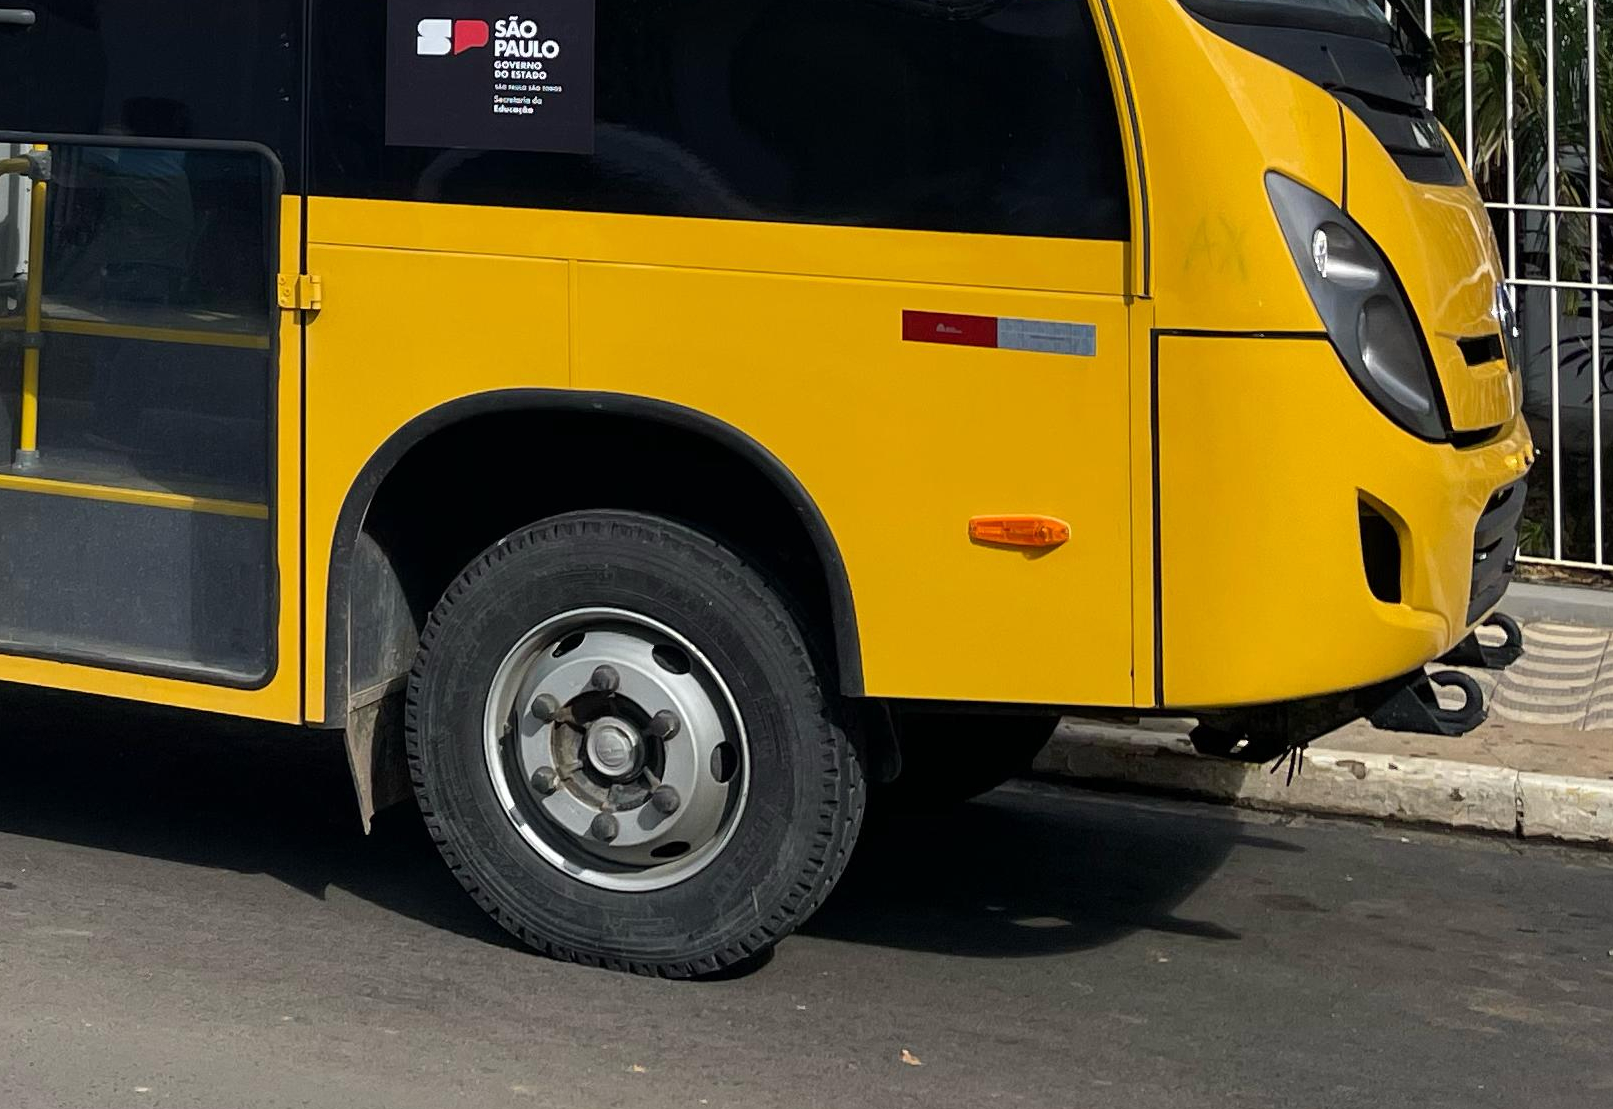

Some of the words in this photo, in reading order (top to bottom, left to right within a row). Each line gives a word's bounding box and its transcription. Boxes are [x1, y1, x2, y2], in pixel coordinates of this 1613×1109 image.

[494, 15, 538, 39] SÃO
[494, 39, 560, 59] PAULO
[493, 60, 543, 71] GOVERNO
[494, 70, 509, 80] DO
[510, 70, 548, 81] ESTADO
[493, 104, 534, 116] Educação
